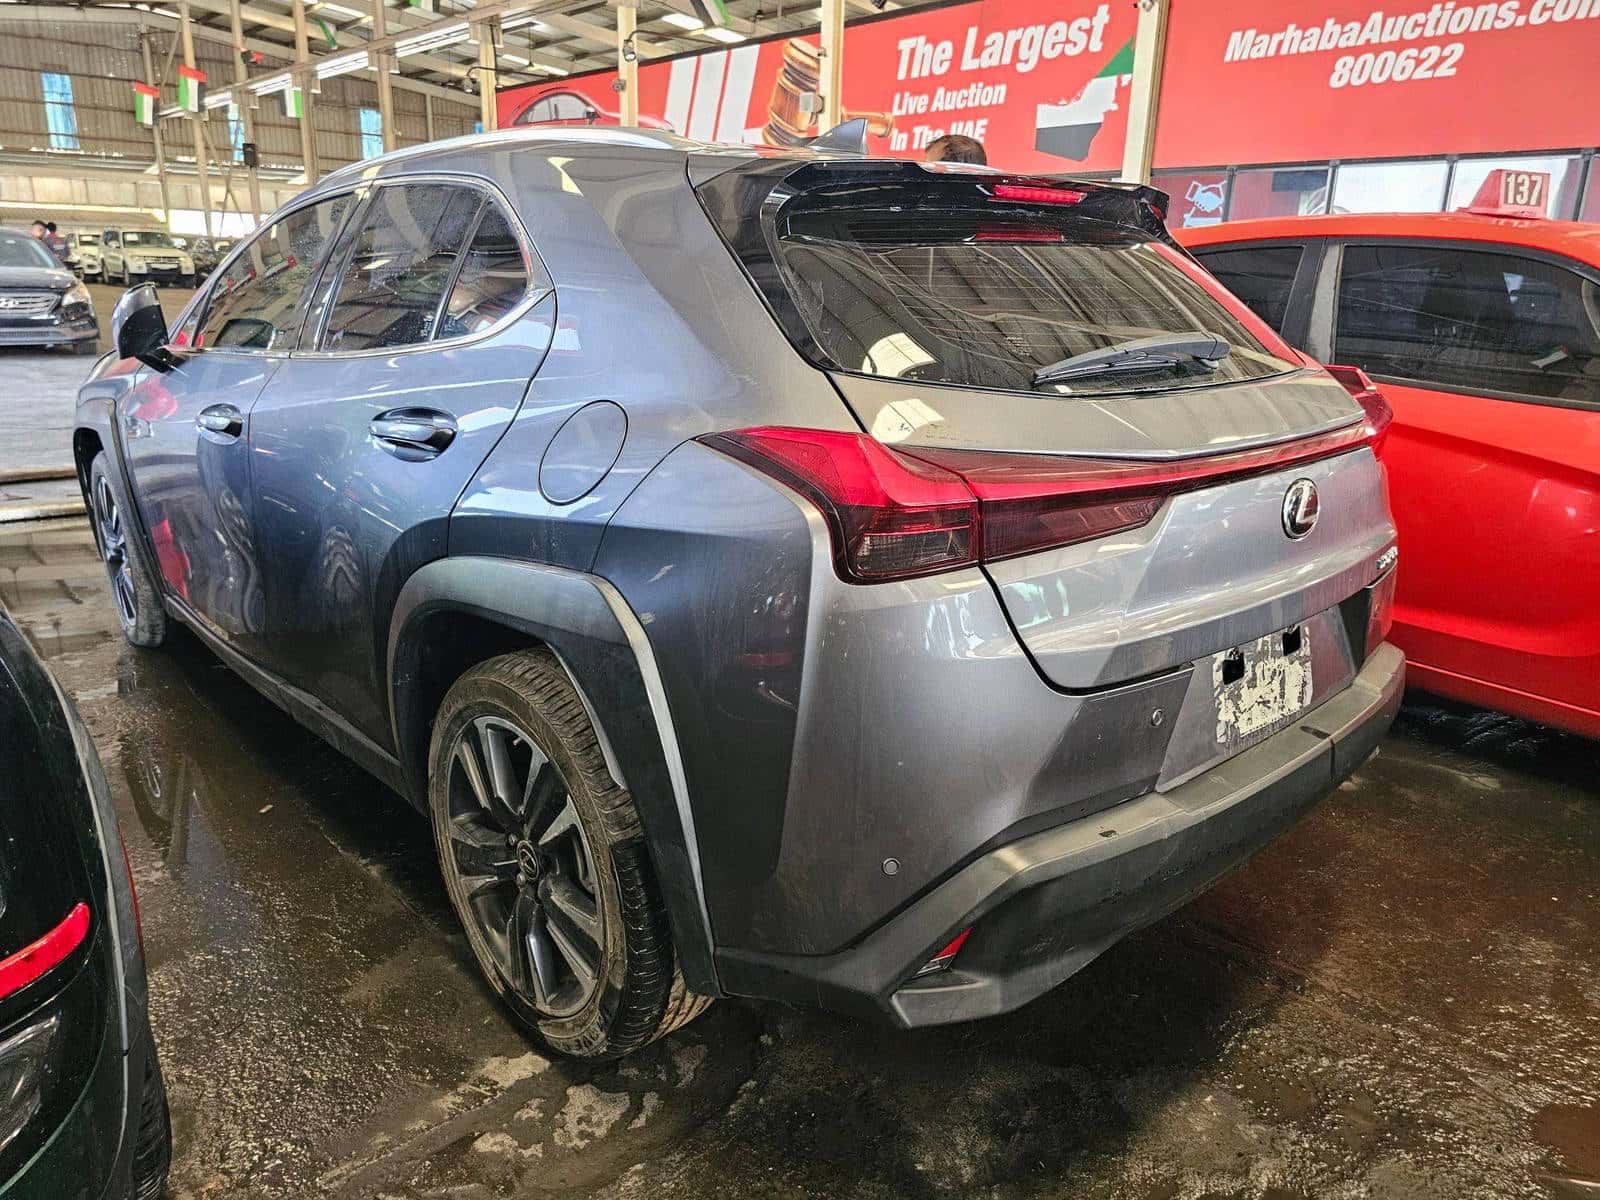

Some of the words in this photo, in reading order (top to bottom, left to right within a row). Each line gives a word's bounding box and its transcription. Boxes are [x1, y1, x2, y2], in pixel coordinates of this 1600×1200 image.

[897, 36, 953, 80] The
[960, 4, 1110, 73] Largest
[1329, 43, 1465, 88] 800622
[892, 92, 929, 117] Live
[930, 82, 1008, 112] Auction
[890, 128, 908, 151] In
[1506, 174, 1543, 206] 137
